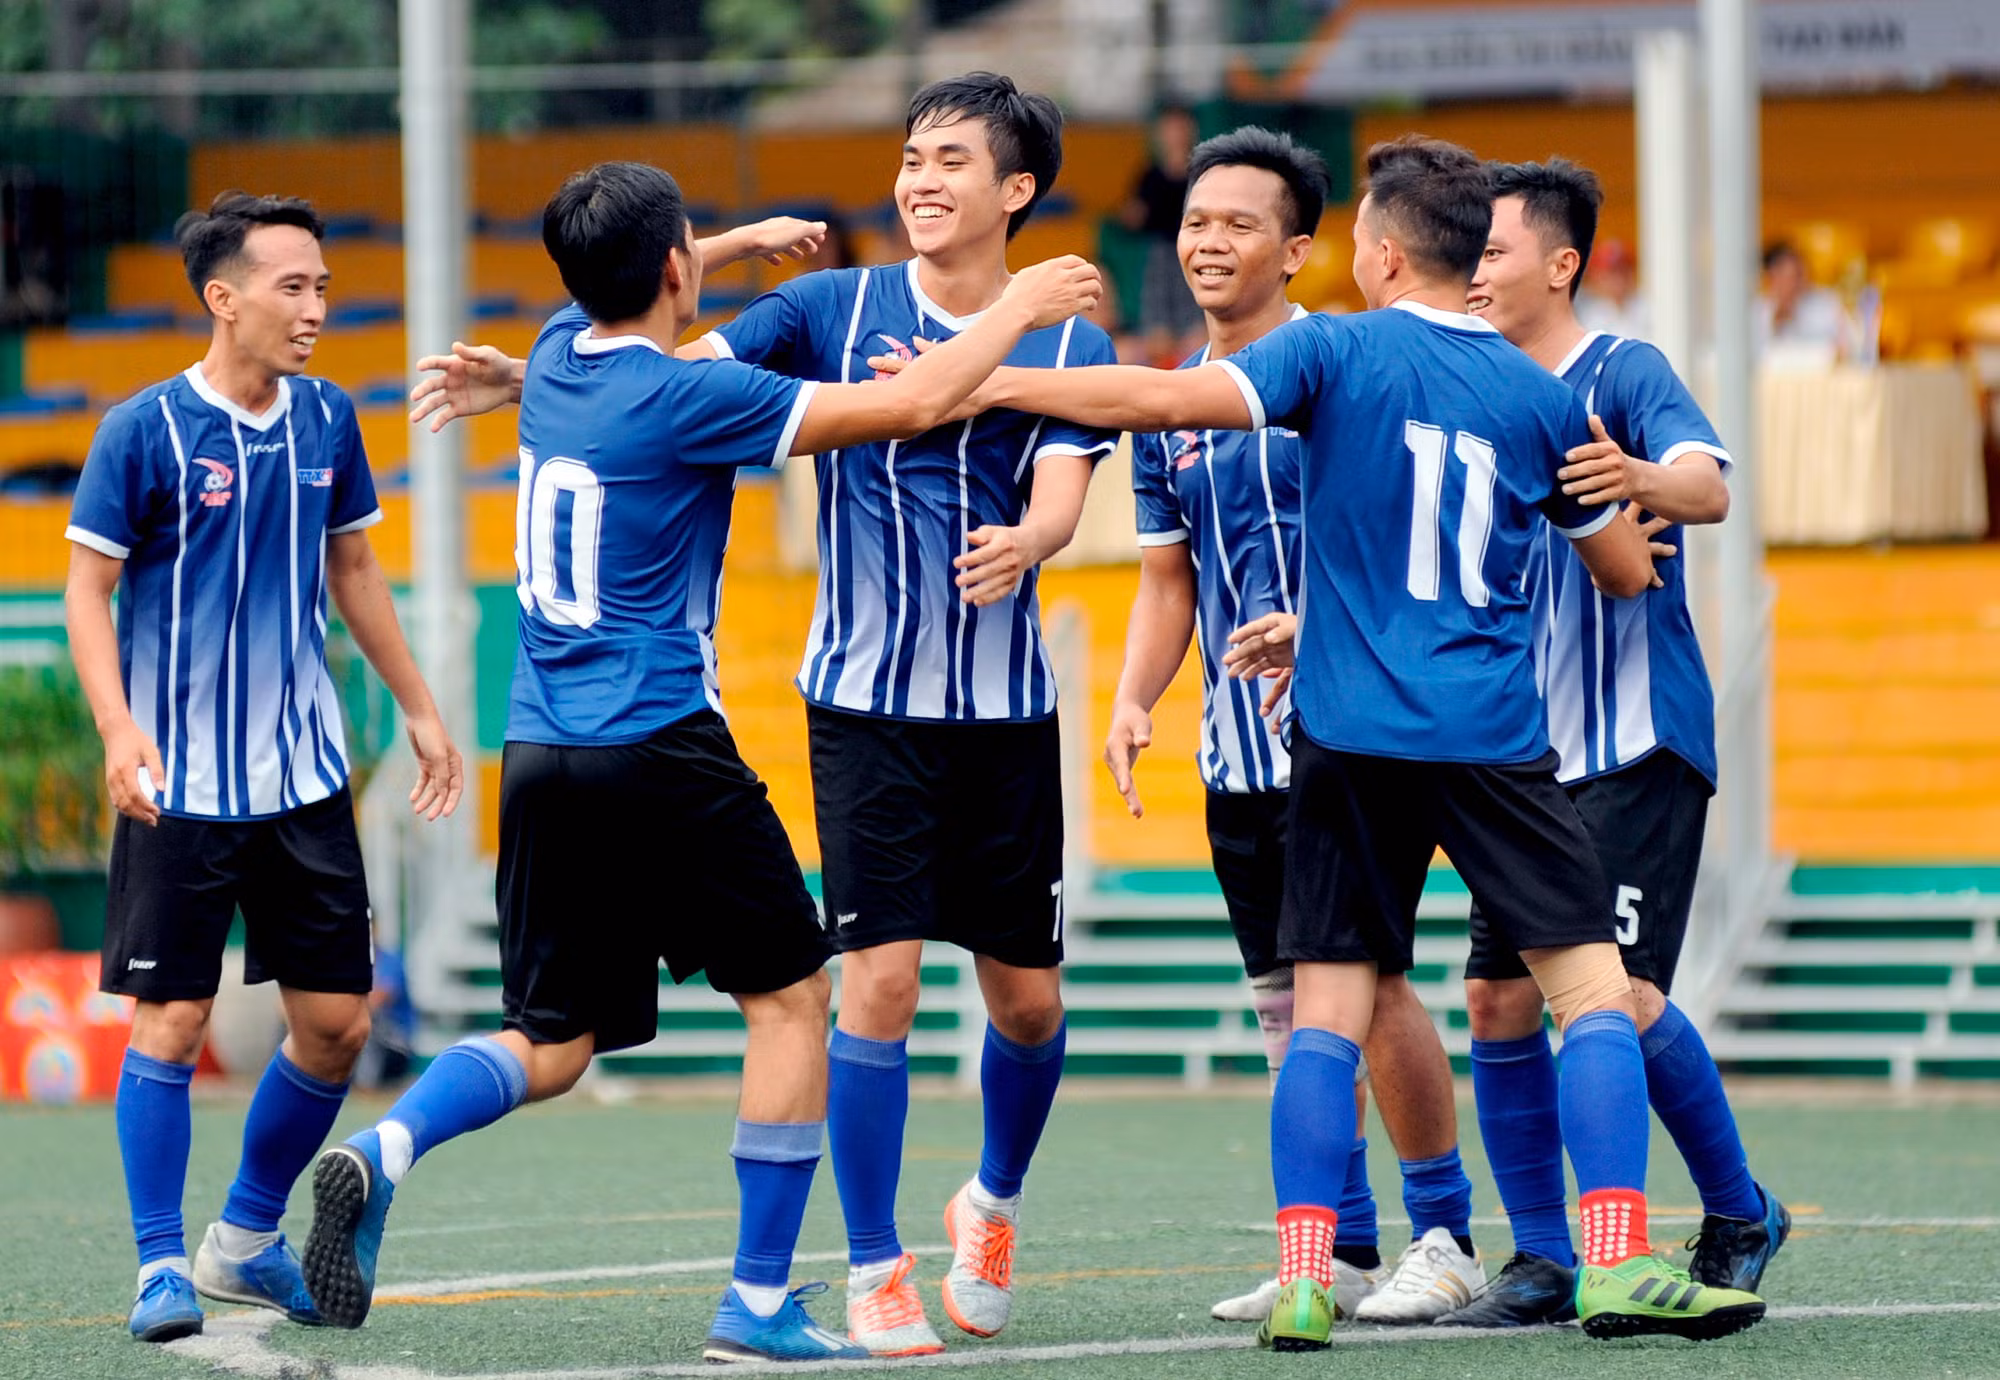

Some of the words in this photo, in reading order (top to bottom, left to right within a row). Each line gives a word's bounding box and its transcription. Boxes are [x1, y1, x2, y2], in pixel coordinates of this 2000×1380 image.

[514, 446, 605, 630] 10
[1404, 420, 1498, 608] 11
[1050, 880, 1062, 942] 7
[1615, 885, 1643, 946] 5
